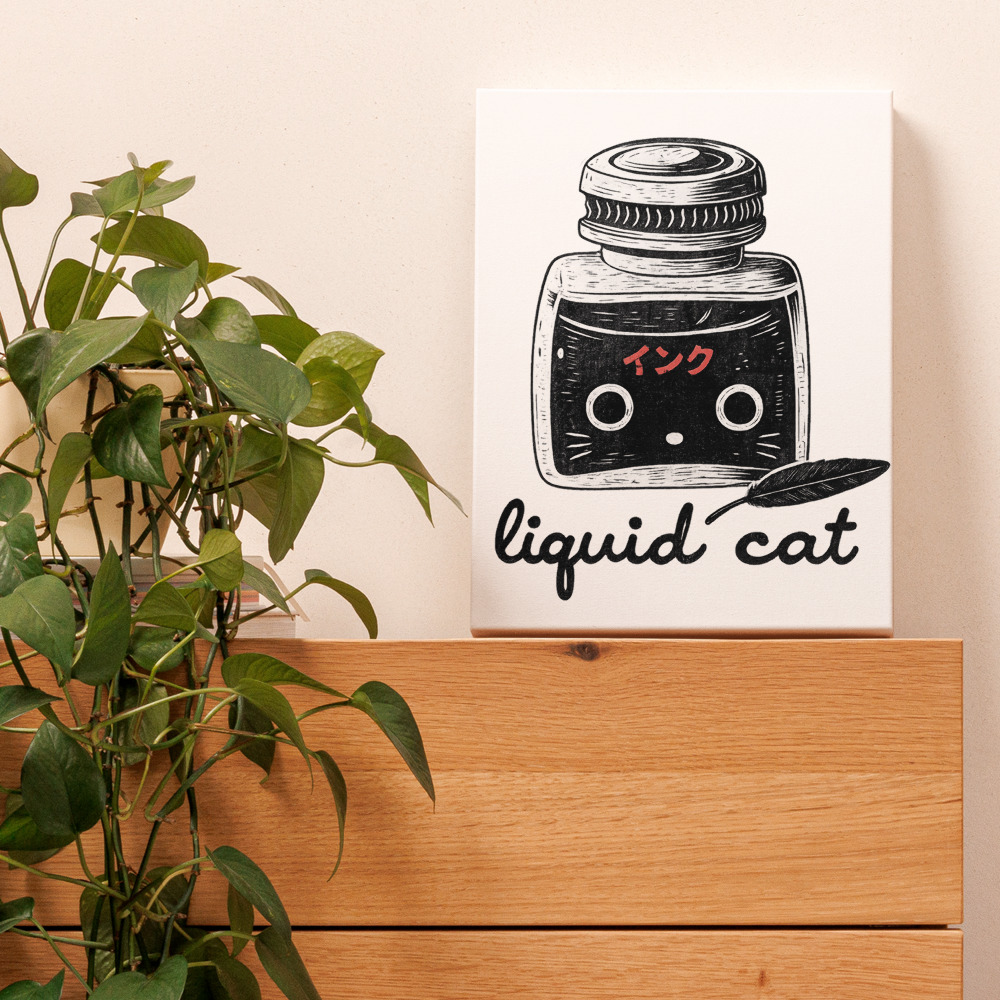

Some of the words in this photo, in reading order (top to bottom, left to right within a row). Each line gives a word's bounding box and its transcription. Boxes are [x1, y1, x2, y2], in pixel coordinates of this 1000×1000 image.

[624, 345, 713, 375] インク
[495, 499, 706, 600] liquid
[736, 508, 858, 565] cat
